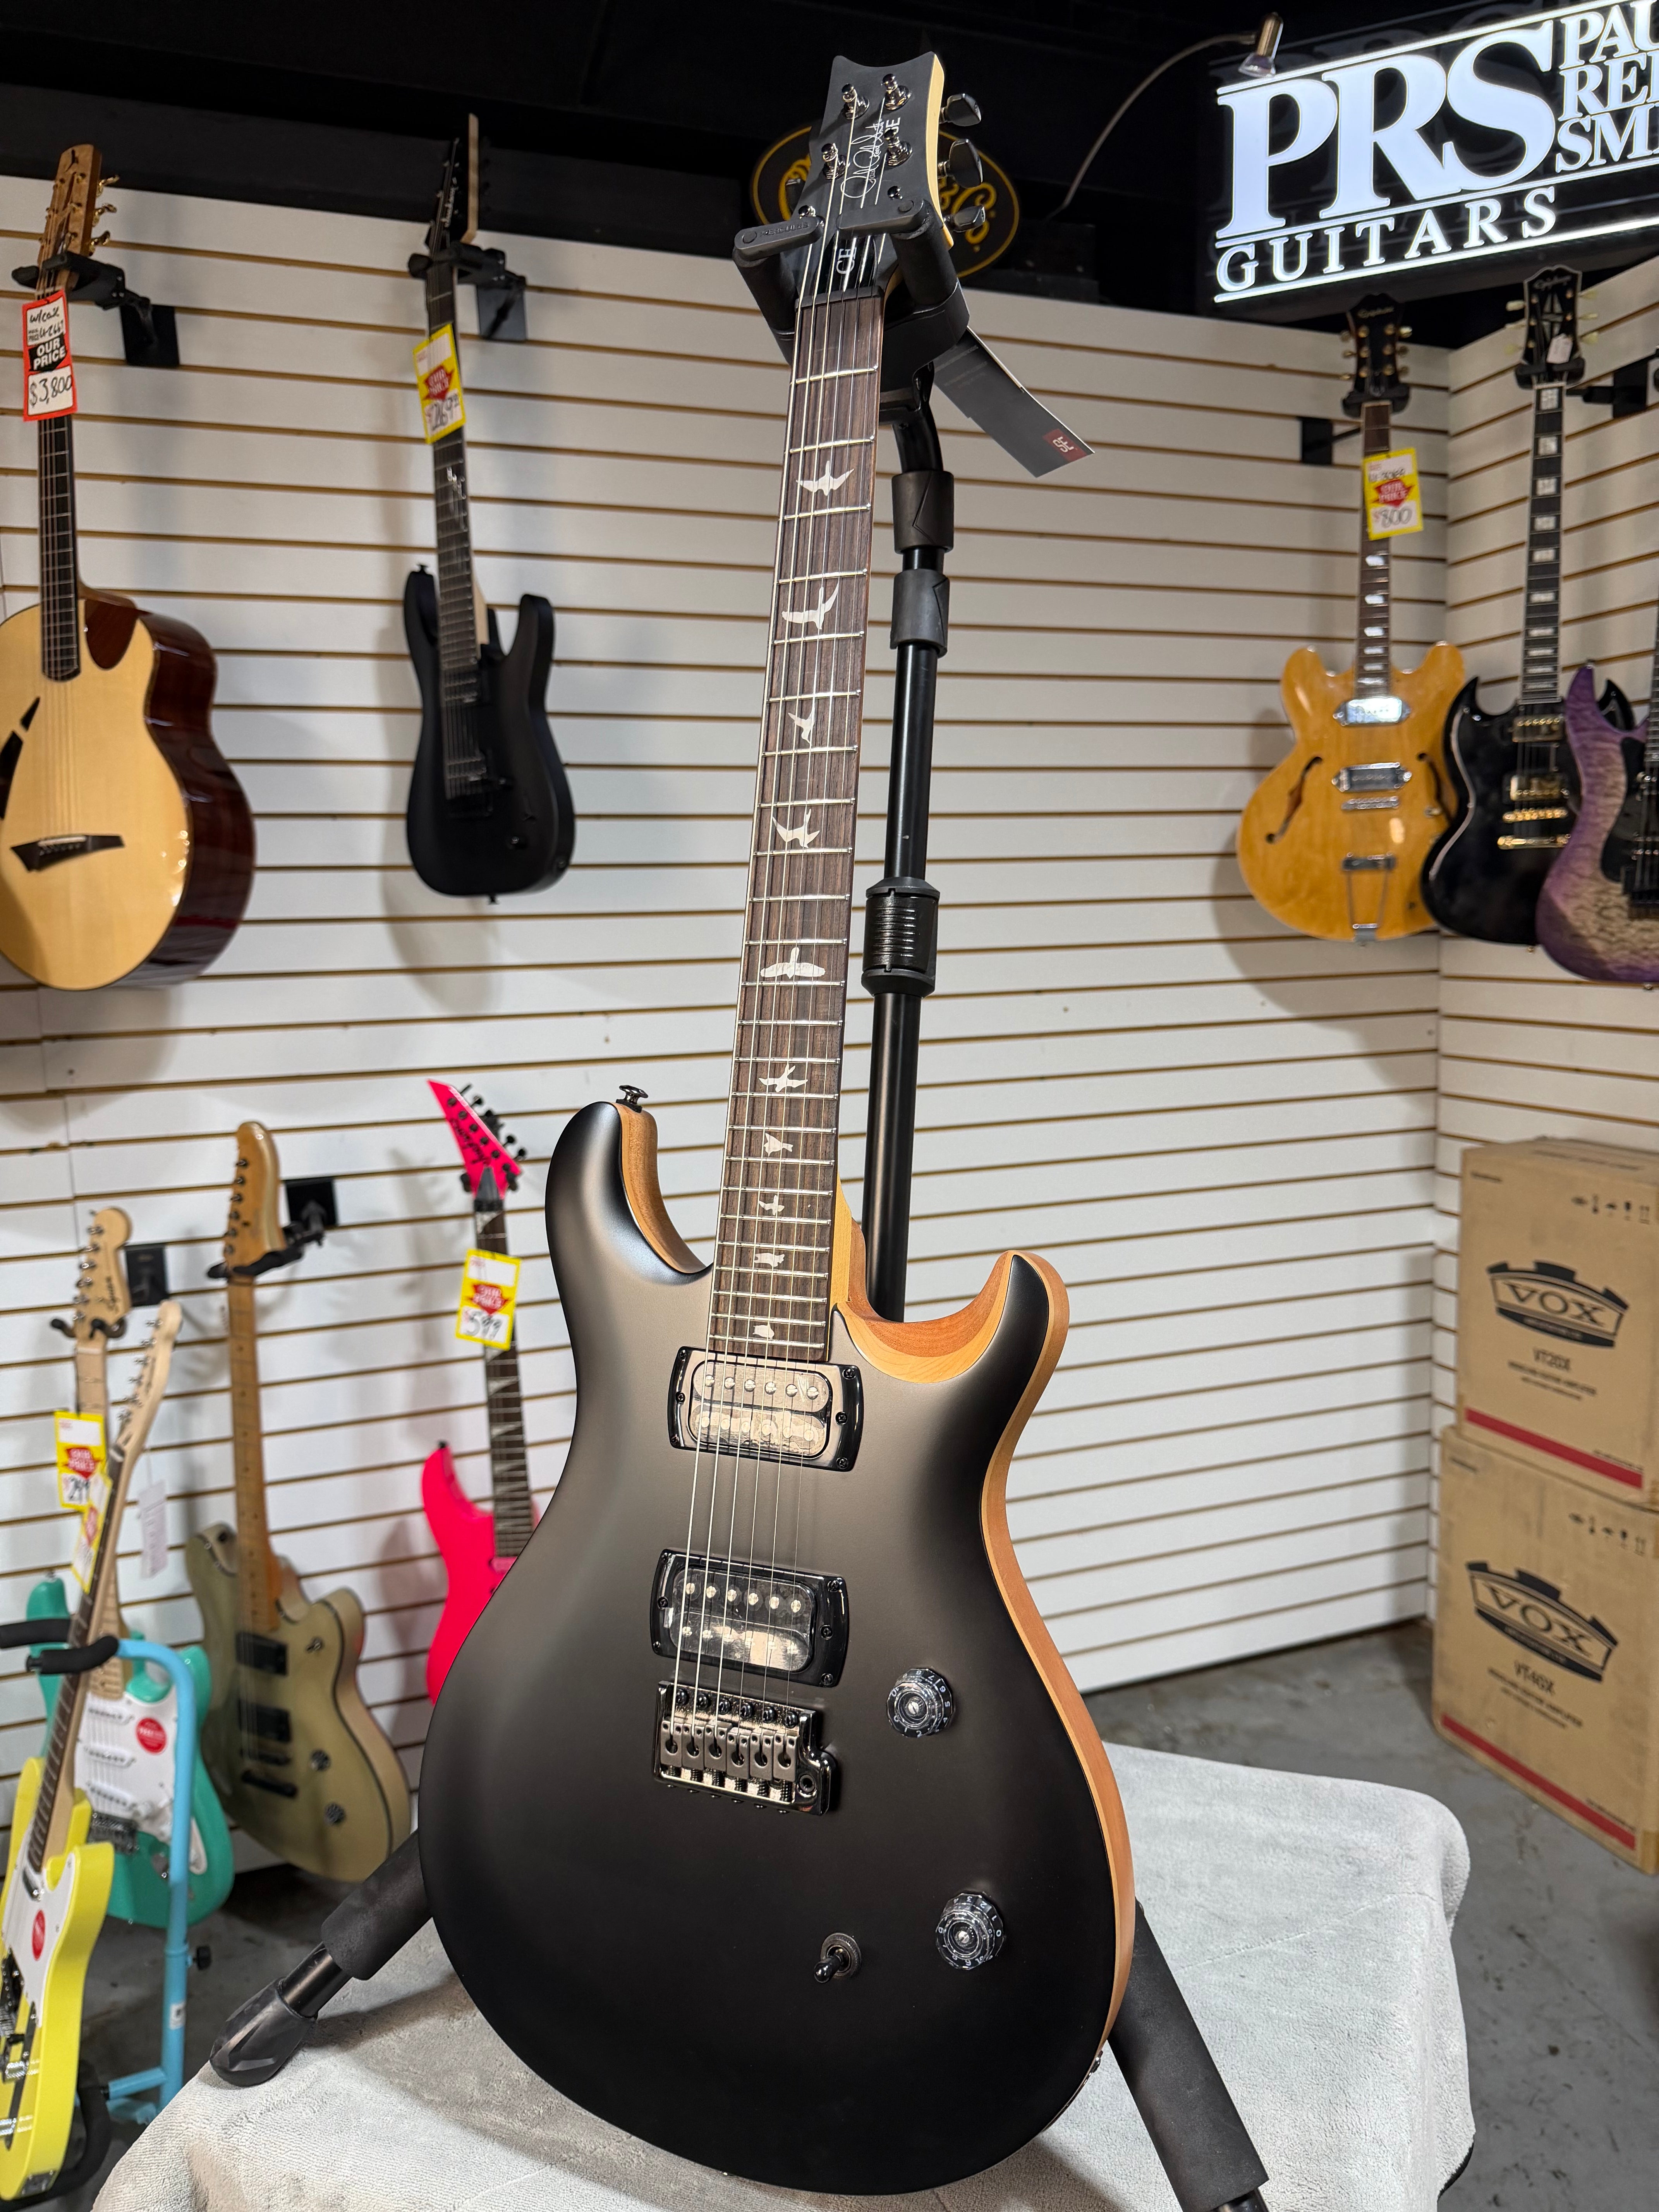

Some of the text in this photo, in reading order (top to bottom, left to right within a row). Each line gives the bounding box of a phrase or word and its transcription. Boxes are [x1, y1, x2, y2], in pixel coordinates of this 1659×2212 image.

[1216, 20, 1556, 239] PRS
[1555, 103, 1659, 173] SM
[1215, 186, 1556, 292] GUITARS
[836, 247, 857, 275] CE
[33, 345, 66, 371] PRICE
[36, 337, 60, 357] OUR
[29, 374, 73, 408] $3,800
[1053, 436, 1074, 453] SE
[1503, 1282, 1606, 1328] VOX
[1480, 1581, 1593, 1659] VOX
[996, 1929, 1002, 1937] 0
